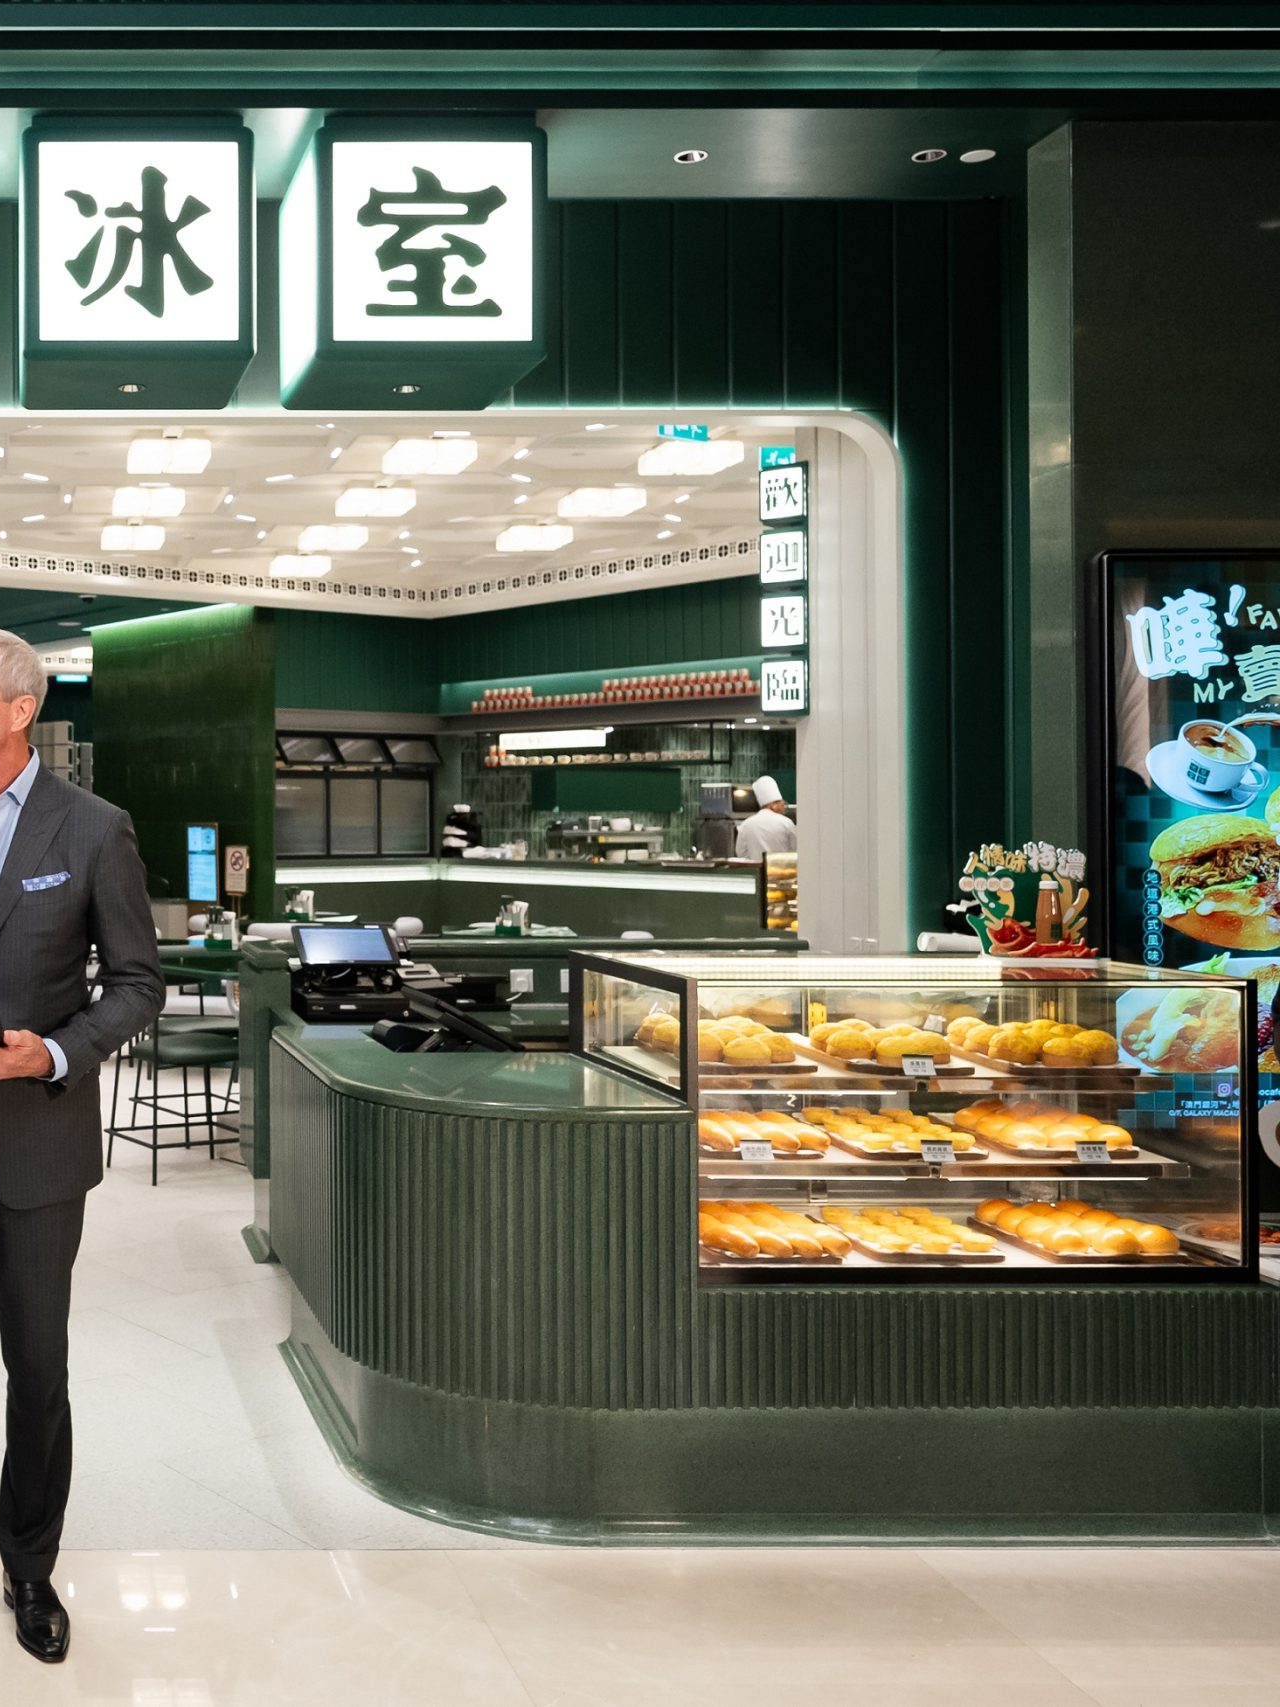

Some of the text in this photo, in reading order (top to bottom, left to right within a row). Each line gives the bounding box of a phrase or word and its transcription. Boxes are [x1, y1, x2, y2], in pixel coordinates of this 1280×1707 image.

[764, 477, 800, 701] 歡迎光臨
[1246, 603, 1280, 630] FA
[1193, 678, 1235, 704] MY
